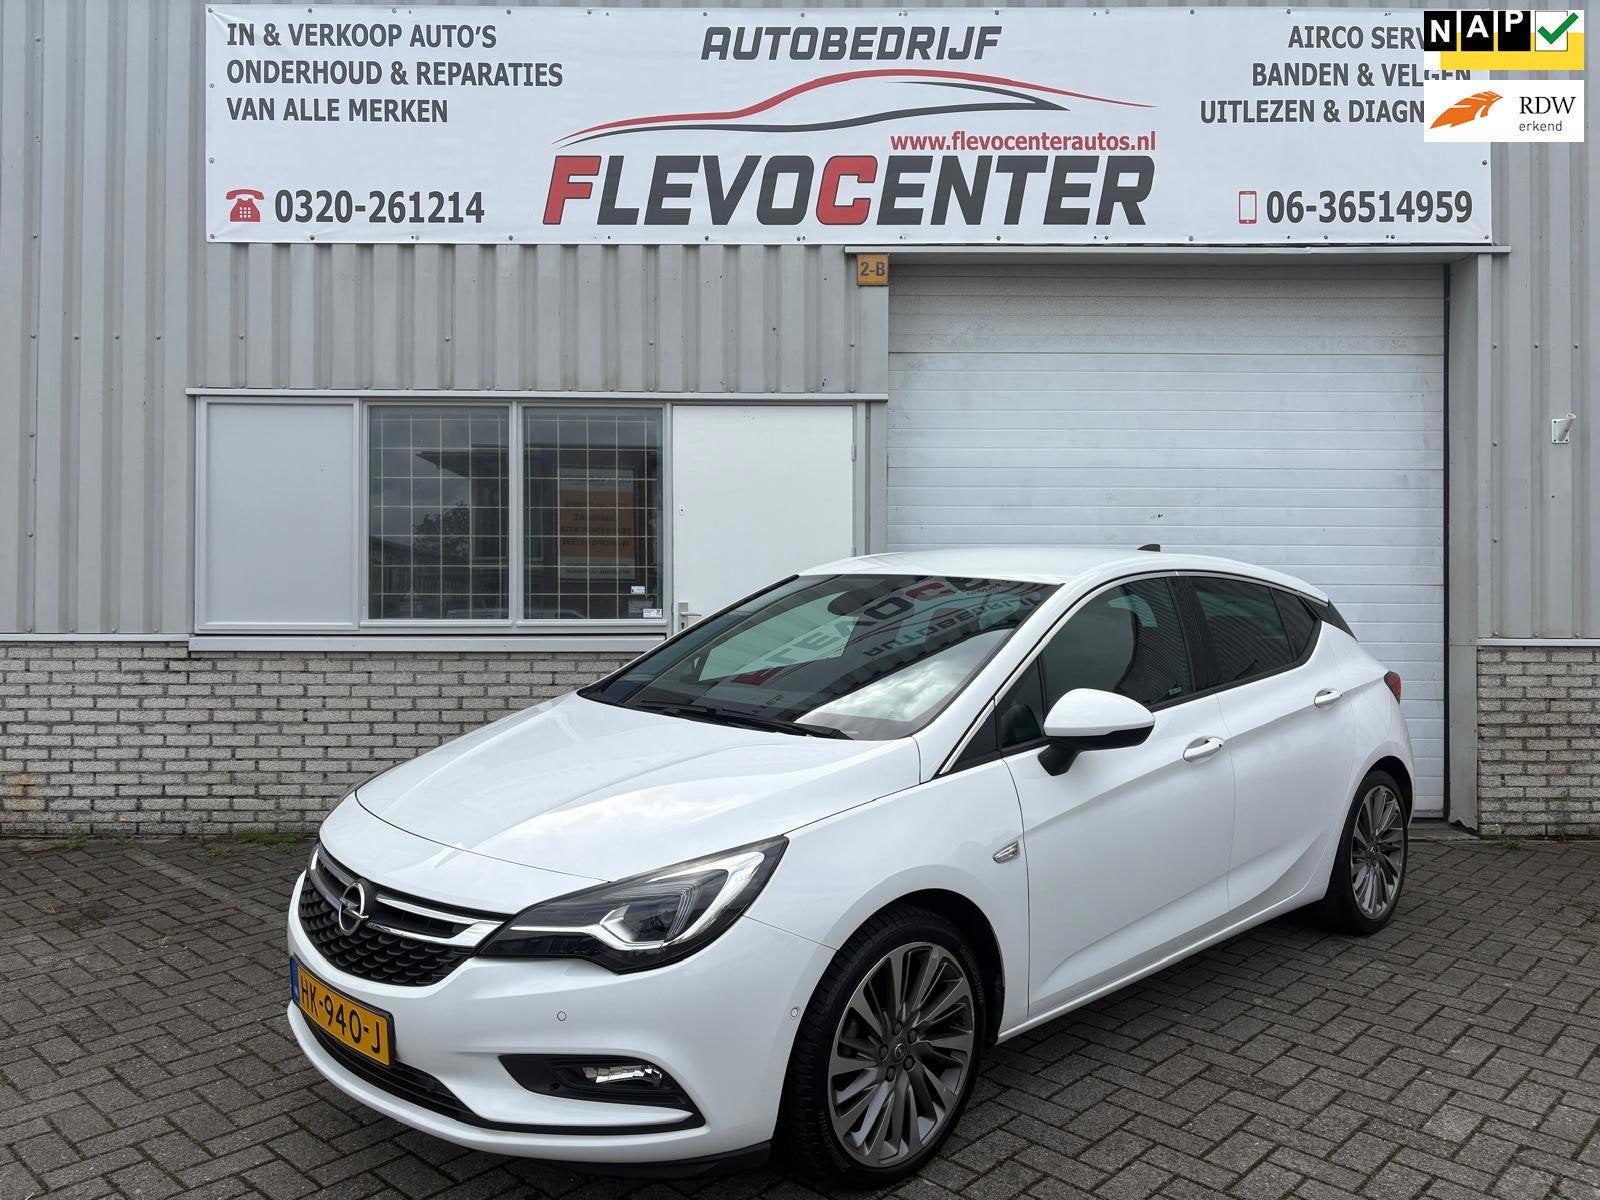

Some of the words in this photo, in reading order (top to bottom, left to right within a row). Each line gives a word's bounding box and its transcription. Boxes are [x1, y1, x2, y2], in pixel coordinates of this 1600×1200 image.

[227, 23, 254, 46] IN
[264, 23, 281, 46] &
[288, 23, 402, 47] VERKOOP
[410, 24, 497, 48] AUTO’S
[701, 26, 1002, 60] AUTOBEDRIJF
[1288, 25, 1363, 49] AIRCO
[227, 60, 382, 84] ONDERHOUD
[391, 61, 408, 85] &
[417, 62, 563, 87] REPARATIES
[1253, 63, 1348, 86] BANDEN
[1357, 63, 1375, 86] &
[226, 97, 275, 121] VAN
[283, 98, 339, 121] ALLE
[349, 99, 448, 122] MERKEN
[1201, 100, 1314, 123] UITLEZEN
[1324, 100, 1341, 123] &
[890, 131, 1156, 151] www.flevocenterautos.nl
[543, 155, 1155, 225] FLEVOCENTER
[274, 190, 485, 223] 0320-261214
[1266, 190, 1473, 223] 06-36514959
[860, 261, 885, 276] 2-B
[300, 975, 381, 1054] HK-940-J
